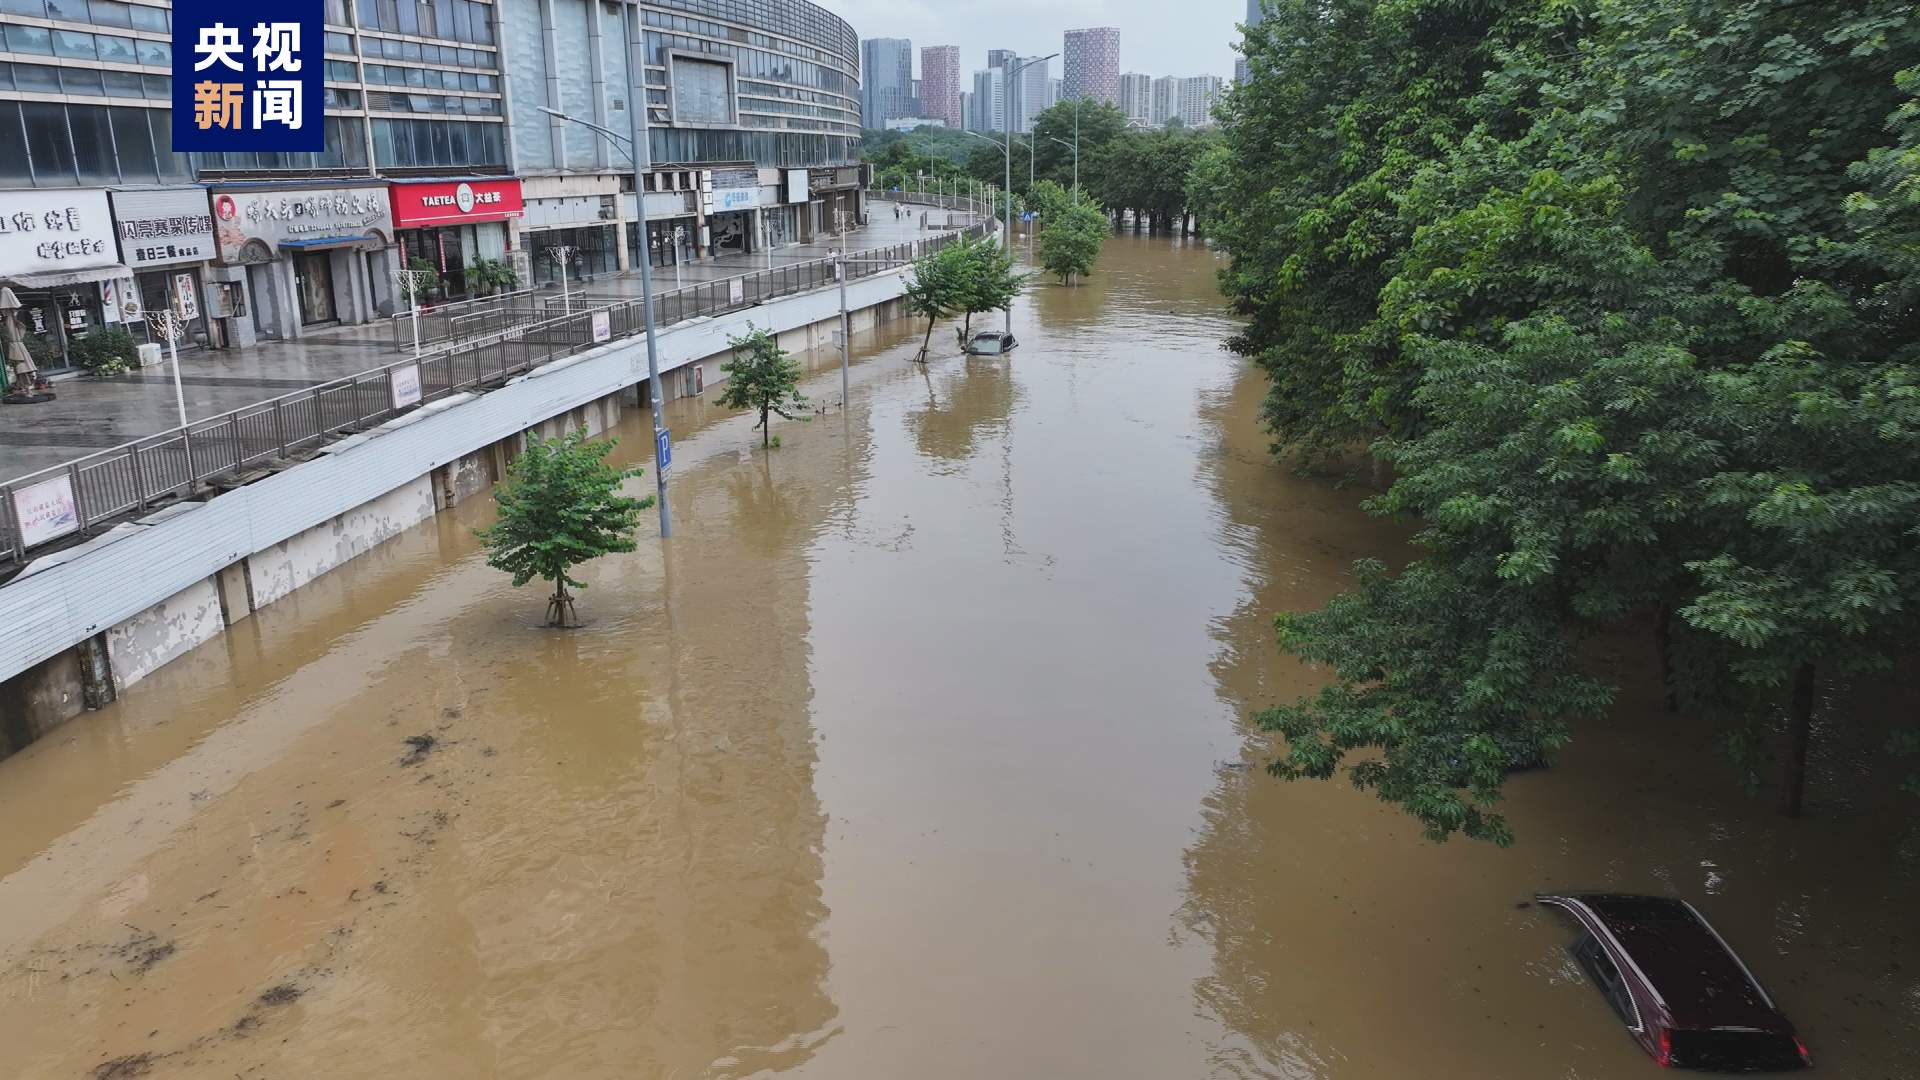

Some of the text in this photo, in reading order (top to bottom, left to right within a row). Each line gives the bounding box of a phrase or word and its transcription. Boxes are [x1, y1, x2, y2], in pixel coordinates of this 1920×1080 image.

[422, 195, 456, 207] TAETEA
[475, 192, 501, 204] 大益茶
[661, 434, 669, 463] P
